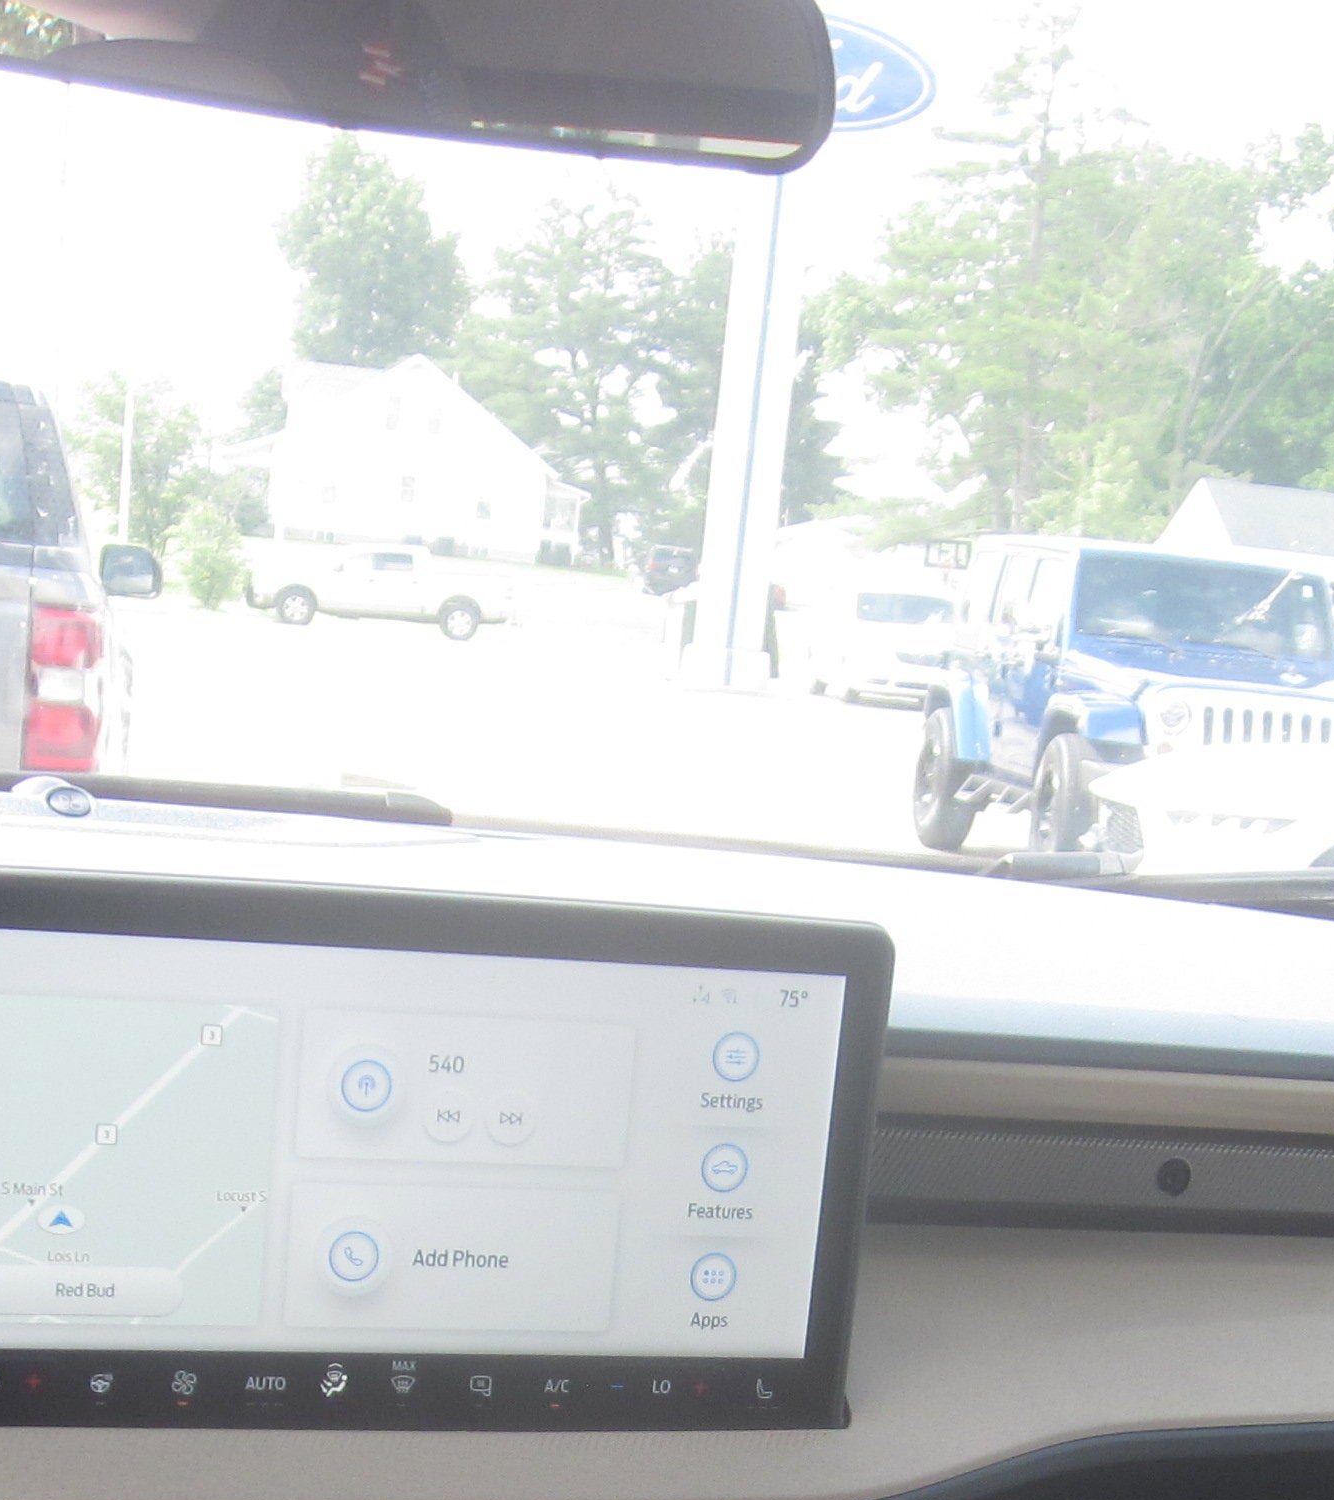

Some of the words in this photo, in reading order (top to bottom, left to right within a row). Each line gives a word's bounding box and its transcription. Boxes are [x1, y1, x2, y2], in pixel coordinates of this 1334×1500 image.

[428, 1054, 466, 1074] 540
[700, 1091, 764, 1113] Settings
[1, 1182, 11, 1195] S
[13, 1182, 46, 1196] Main
[47, 1183, 64, 1196] St
[216, 1190, 257, 1202] Locust
[686, 1202, 754, 1221] Features
[47, 1250, 72, 1262] Lois
[74, 1251, 91, 1263] Ln
[412, 1248, 449, 1268] Add
[452, 1249, 510, 1269] Phone
[55, 1283, 83, 1297] Red
[86, 1284, 116, 1298] Bud
[690, 1311, 729, 1331] Apps
[391, 1360, 417, 1372] MAX
[244, 1375, 287, 1391] AUTO
[543, 1378, 570, 1394] A/C
[651, 1378, 671, 1394] LO
